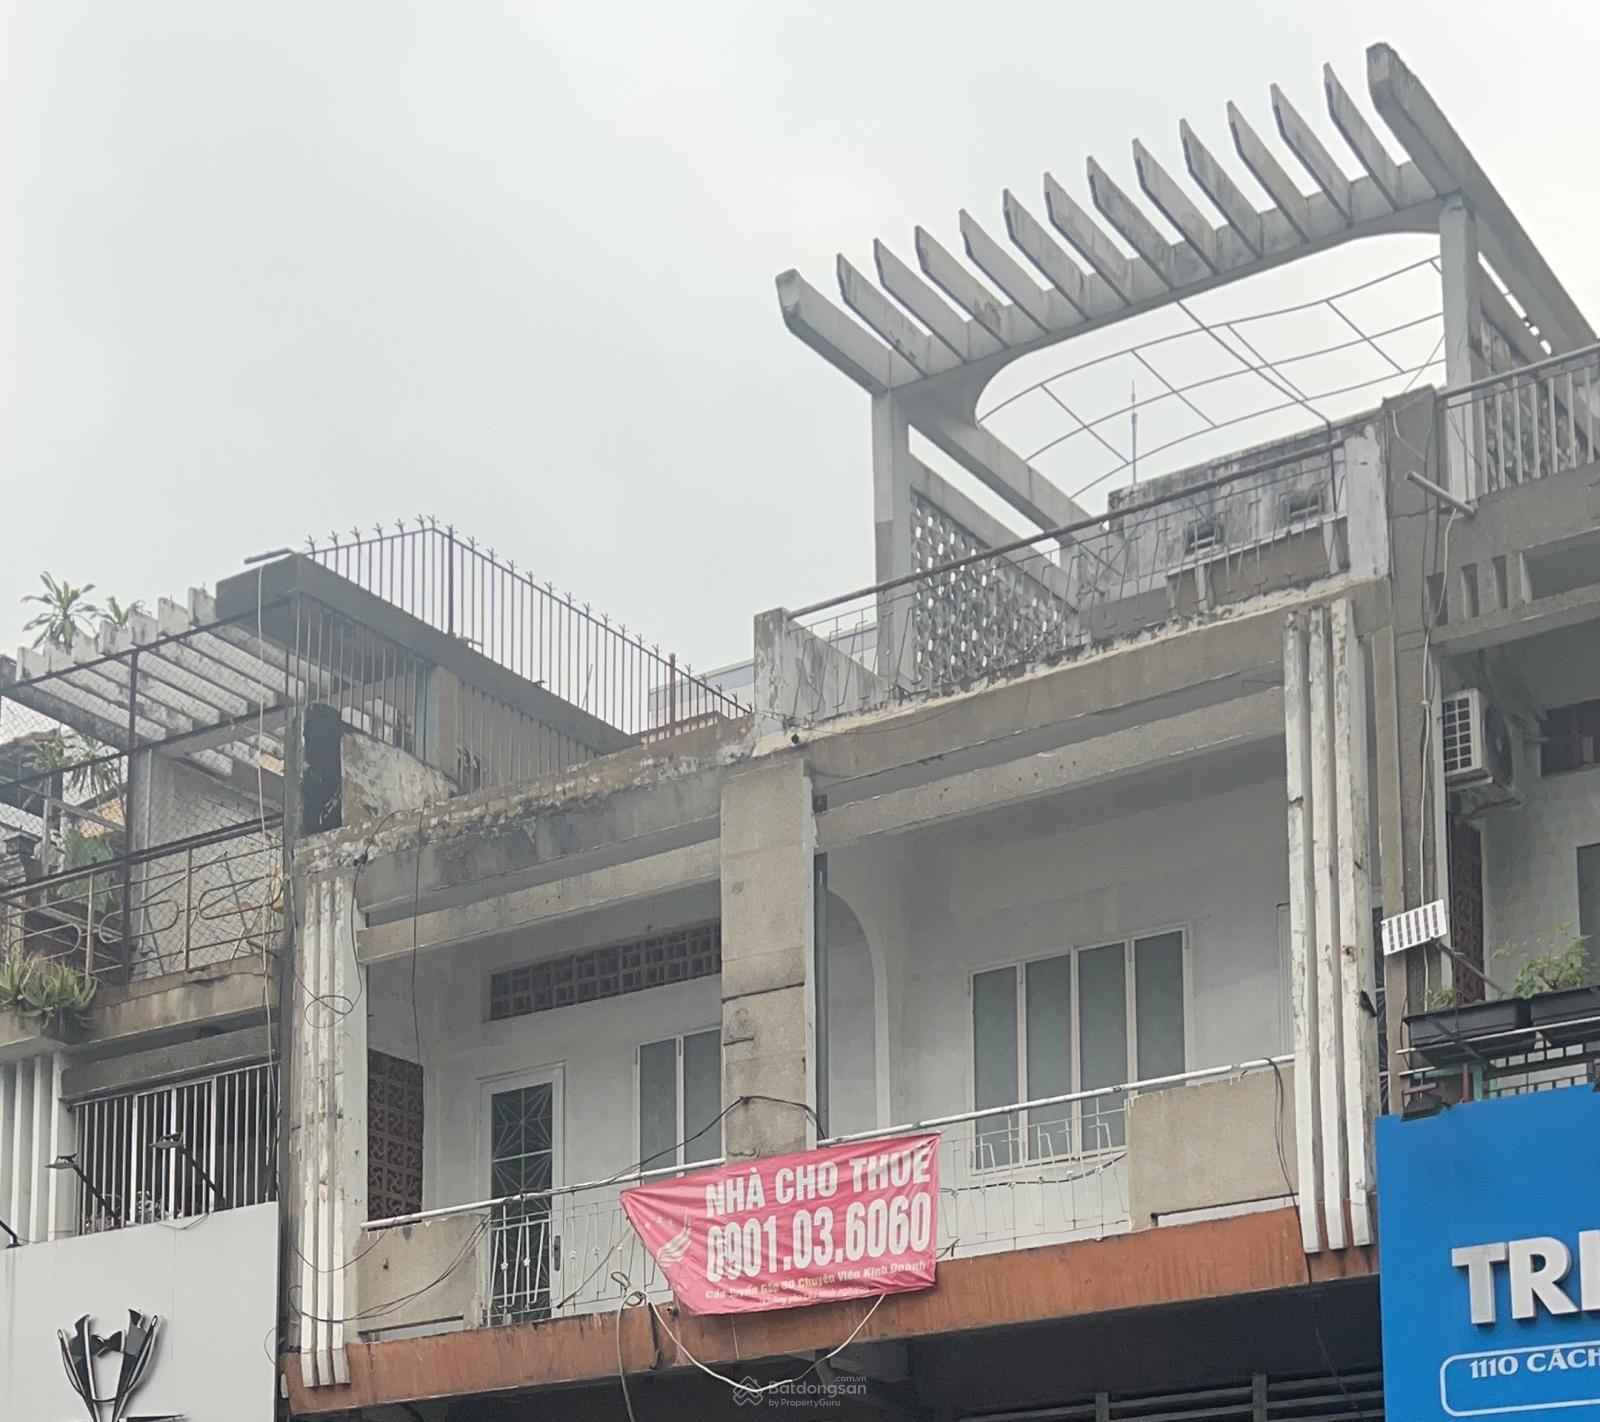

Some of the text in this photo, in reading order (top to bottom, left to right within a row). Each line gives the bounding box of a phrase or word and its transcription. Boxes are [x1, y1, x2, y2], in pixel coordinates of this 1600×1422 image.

[706, 1167, 766, 1218] NHÀ
[775, 1161, 838, 1204] CHO
[707, 1192, 932, 1283] 0901.03.6060
[1470, 1355, 1518, 1379] 1110
